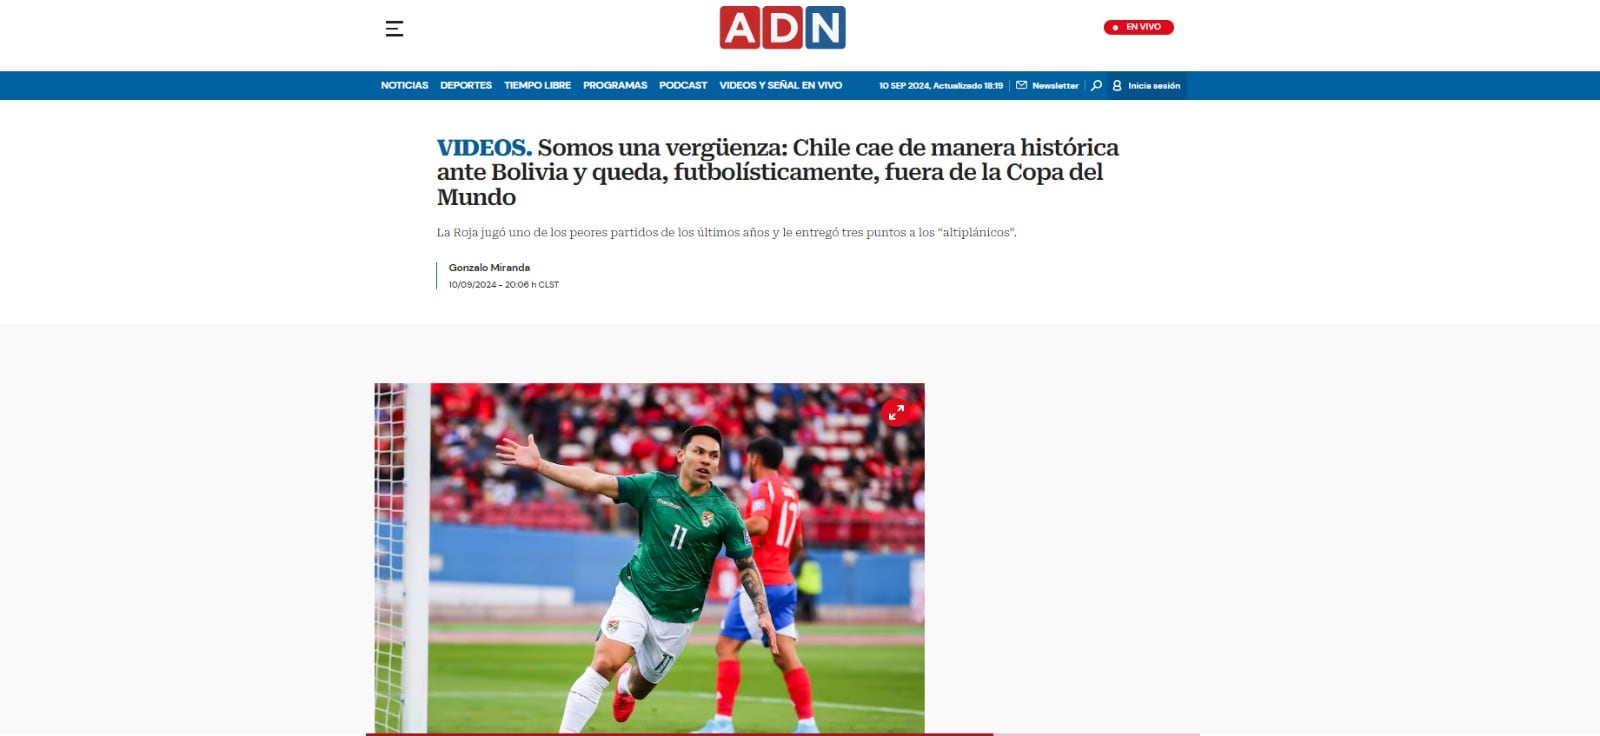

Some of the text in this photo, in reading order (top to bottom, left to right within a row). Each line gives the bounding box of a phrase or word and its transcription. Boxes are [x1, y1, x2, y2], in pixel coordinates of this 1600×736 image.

[723, 11, 841, 44] ADN
[1126, 22, 1162, 31] EN VIVO
[380, 80, 430, 90] NOTICIAS
[439, 80, 493, 90] DEPORTES
[503, 80, 572, 90] TIEMPO LIBRE
[582, 80, 649, 90] PROGRAMAS
[658, 80, 709, 90] PODCAST
[719, 79, 844, 90] VIDEOS Y SEÑAL EN VIVO
[879, 81, 1005, 91] 10 SEP 2024, Actualizado 18:19
[1032, 81, 1080, 90] Newsletter
[1128, 81, 1181, 90] Inicia sesión
[436, 136, 1120, 162] VIDEOS. Somos una vergüenza: Chile cae de manera histórica
[436, 160, 1104, 185] ante Bolivia y queda, futbolísticamente, fuera de la Copa del
[436, 187, 517, 206] Mundo
[437, 226, 1017, 240] La Roja jugó uno de los peores partidos de los últimos años y le entregó tres puntos a los “altiplánicos”.
[448, 262, 531, 272] Gonzalo Miranda
[449, 280, 497, 289] 10/09/2024
[505, 280, 530, 289] 20:06
[531, 280, 537, 289] h
[538, 280, 560, 289] CLST
[777, 501, 798, 548] 17
[670, 524, 688, 550] 11
[654, 653, 674, 674] 11
